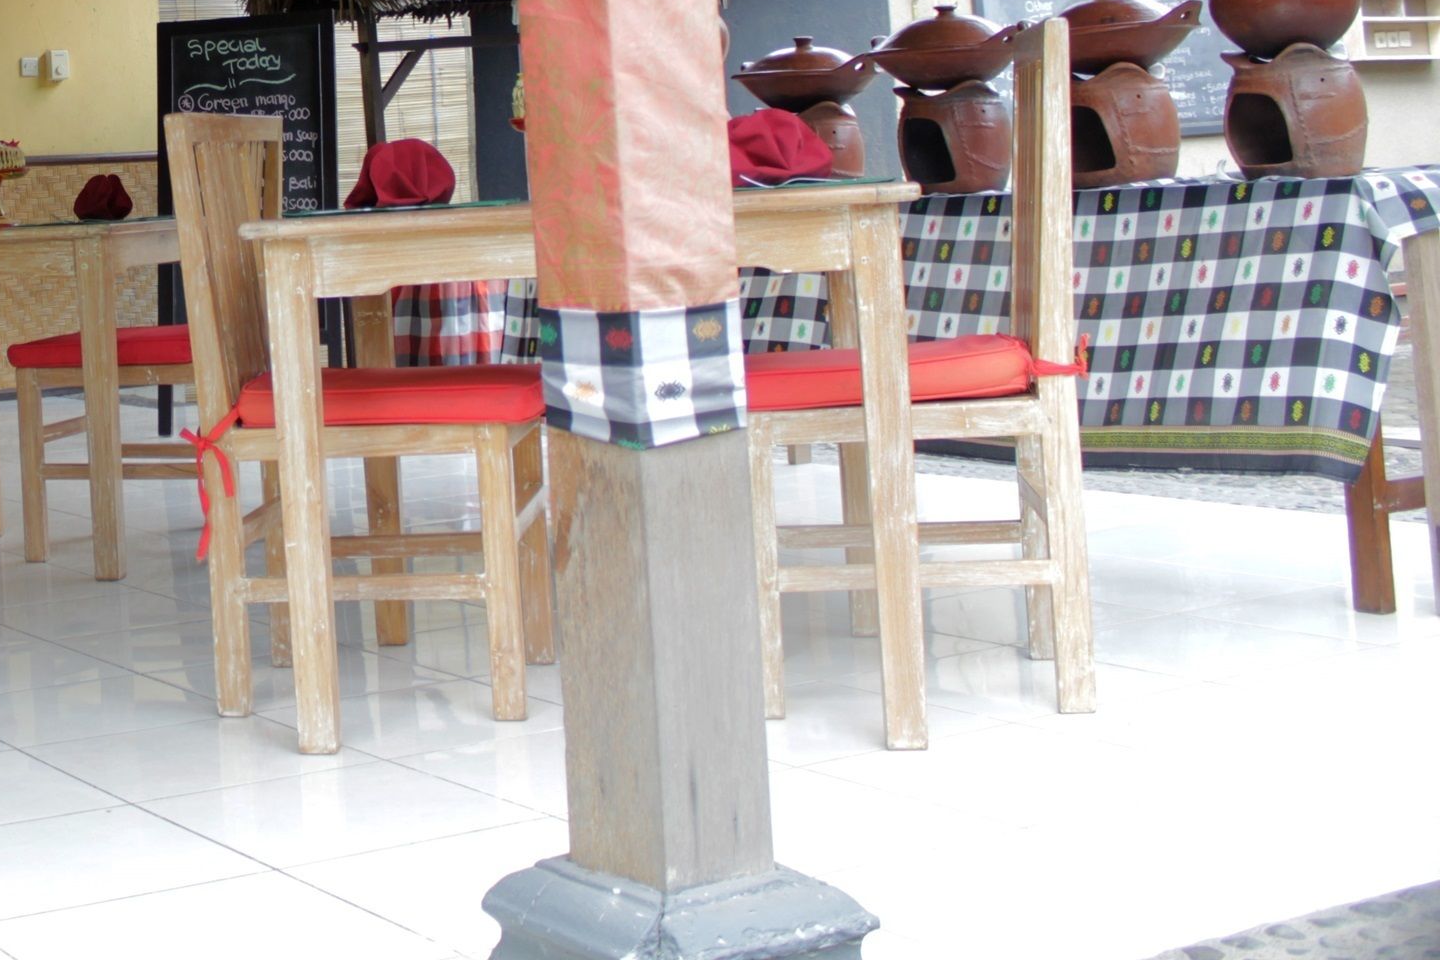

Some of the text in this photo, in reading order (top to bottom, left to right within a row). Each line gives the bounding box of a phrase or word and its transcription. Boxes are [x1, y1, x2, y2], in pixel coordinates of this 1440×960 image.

[187, 37, 266, 61] Special
[222, 53, 281, 74] Today
[197, 93, 296, 113] Green mango
[289, 176, 317, 192] Bali
